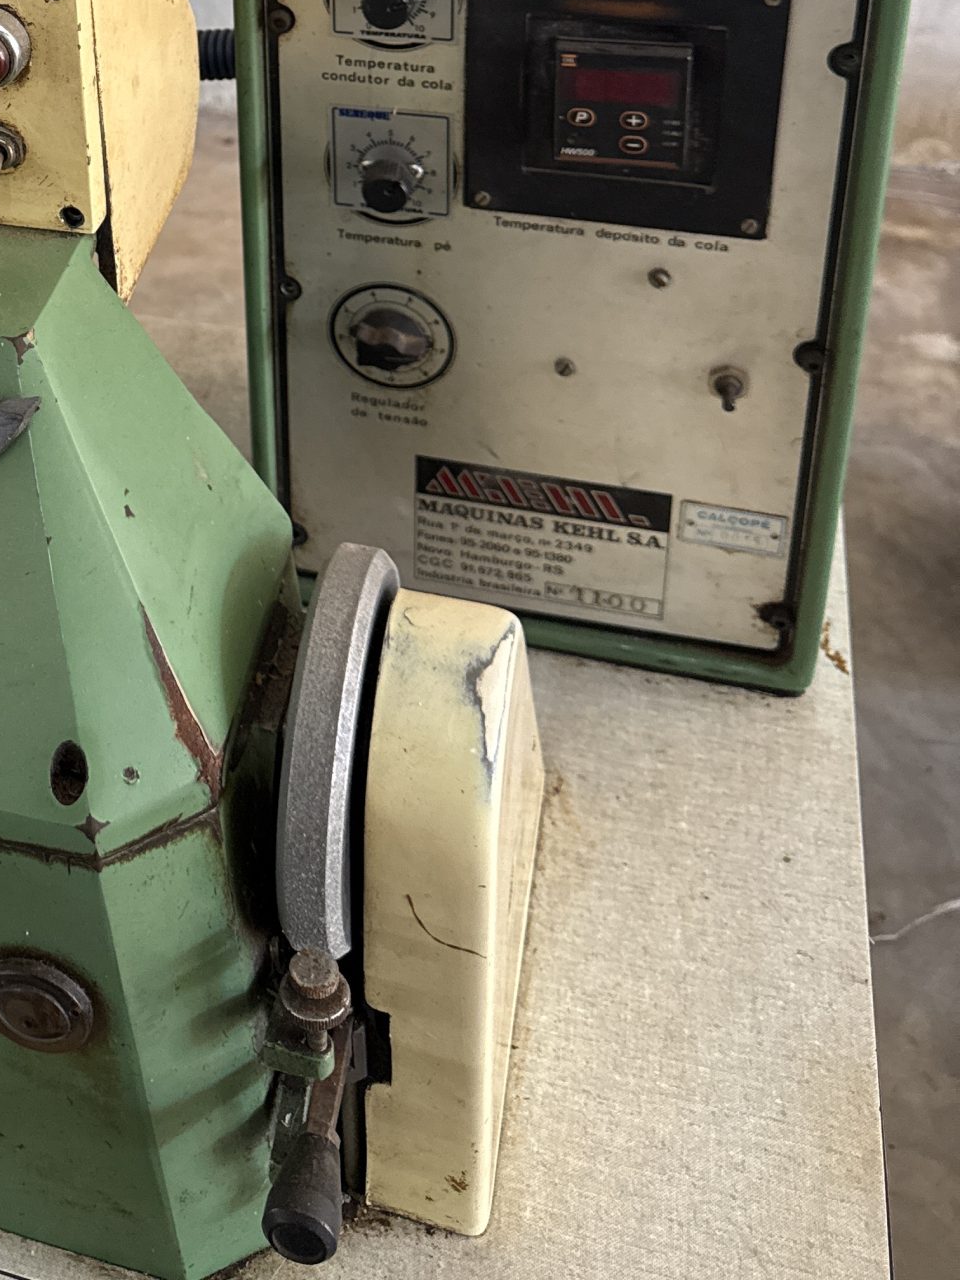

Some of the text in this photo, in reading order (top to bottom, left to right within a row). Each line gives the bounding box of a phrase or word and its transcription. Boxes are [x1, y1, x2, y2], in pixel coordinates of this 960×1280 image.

[415, 25, 425, 33] 10
[336, 54, 436, 74] Temperatura
[321, 71, 454, 91] condutor da cola
[575, 111, 588, 123] P
[337, 228, 452, 252] Temperatura pé
[493, 216, 585, 236] Temperatura
[667, 236, 686, 248] da
[694, 240, 730, 252] cola
[351, 392, 426, 411] Regulador
[351, 408, 367, 417] de
[418, 498, 544, 530] MAQUINAS
[554, 521, 620, 543] KEHL
[418, 517, 443, 530] Rua
[465, 525, 481, 536] de
[555, 539, 593, 554] 2349
[417, 542, 453, 557] Novo
[479, 579, 541, 596] brasileira
